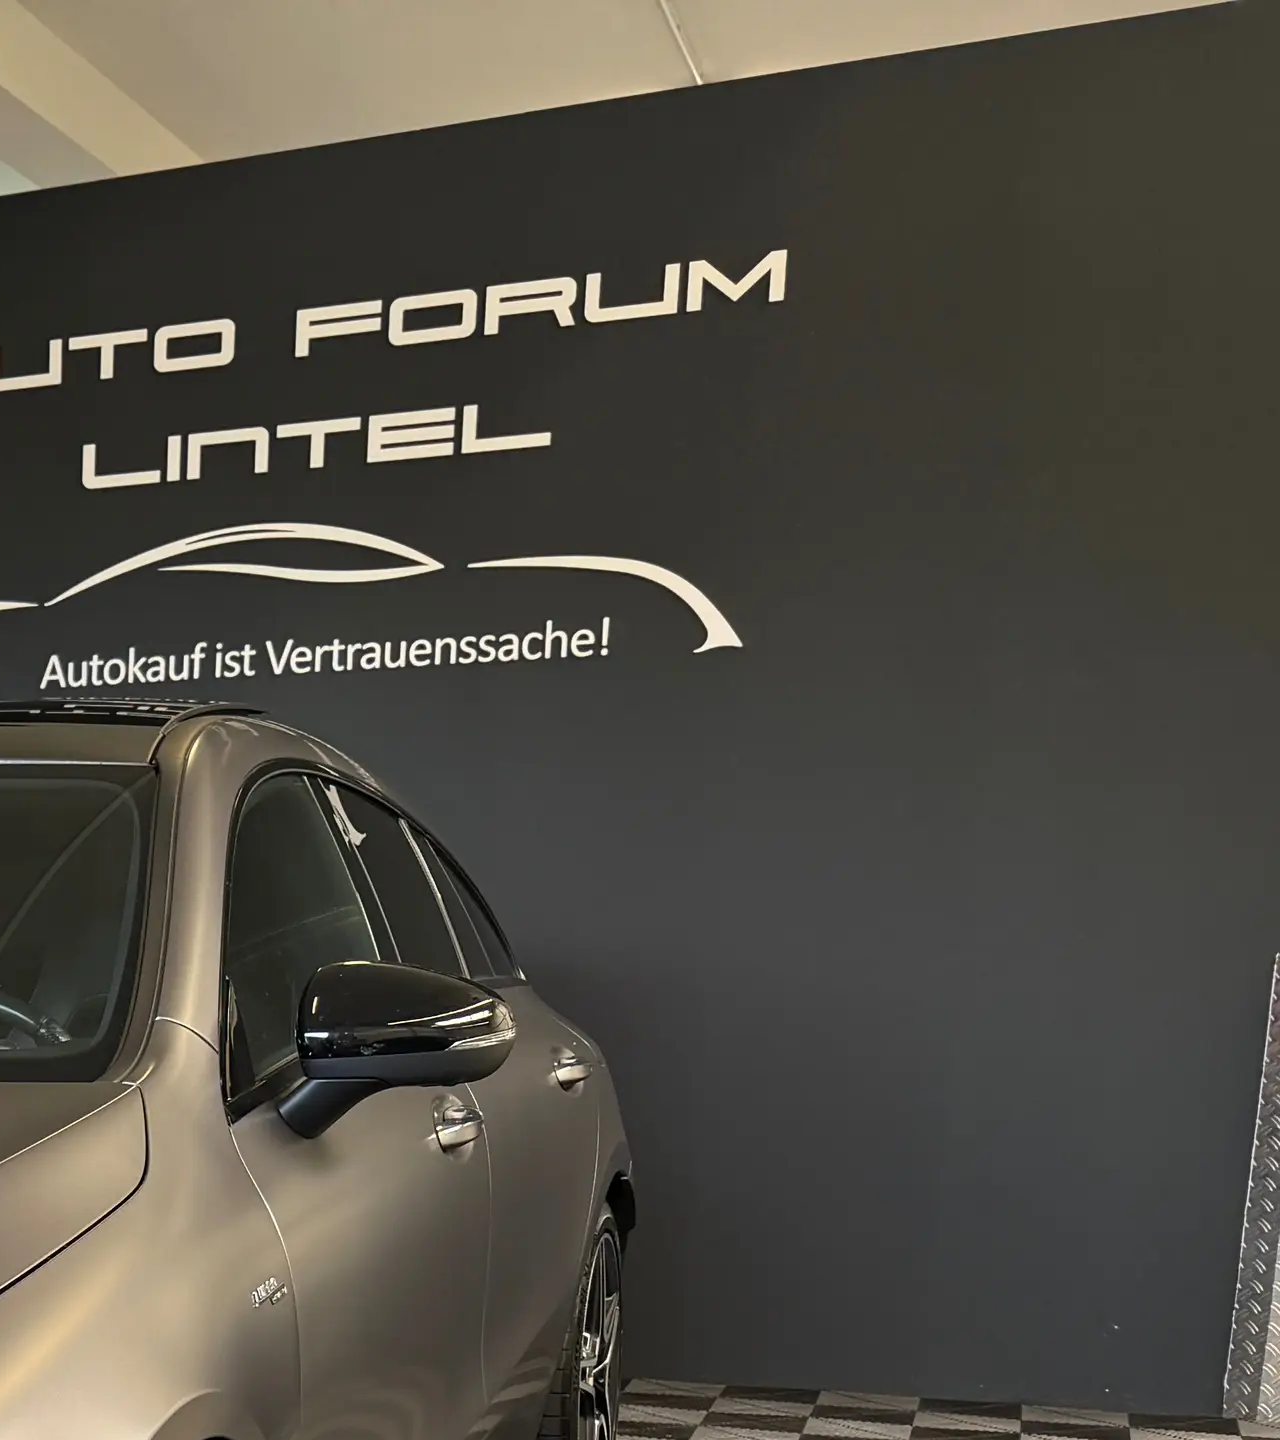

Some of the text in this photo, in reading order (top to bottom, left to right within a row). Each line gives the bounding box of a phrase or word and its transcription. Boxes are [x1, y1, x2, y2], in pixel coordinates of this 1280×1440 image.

[295, 249, 788, 358] FORUM
[82, 405, 552, 490] LINTEL
[40, 616, 610, 690] Autokauf ist Vertrauenssache!
